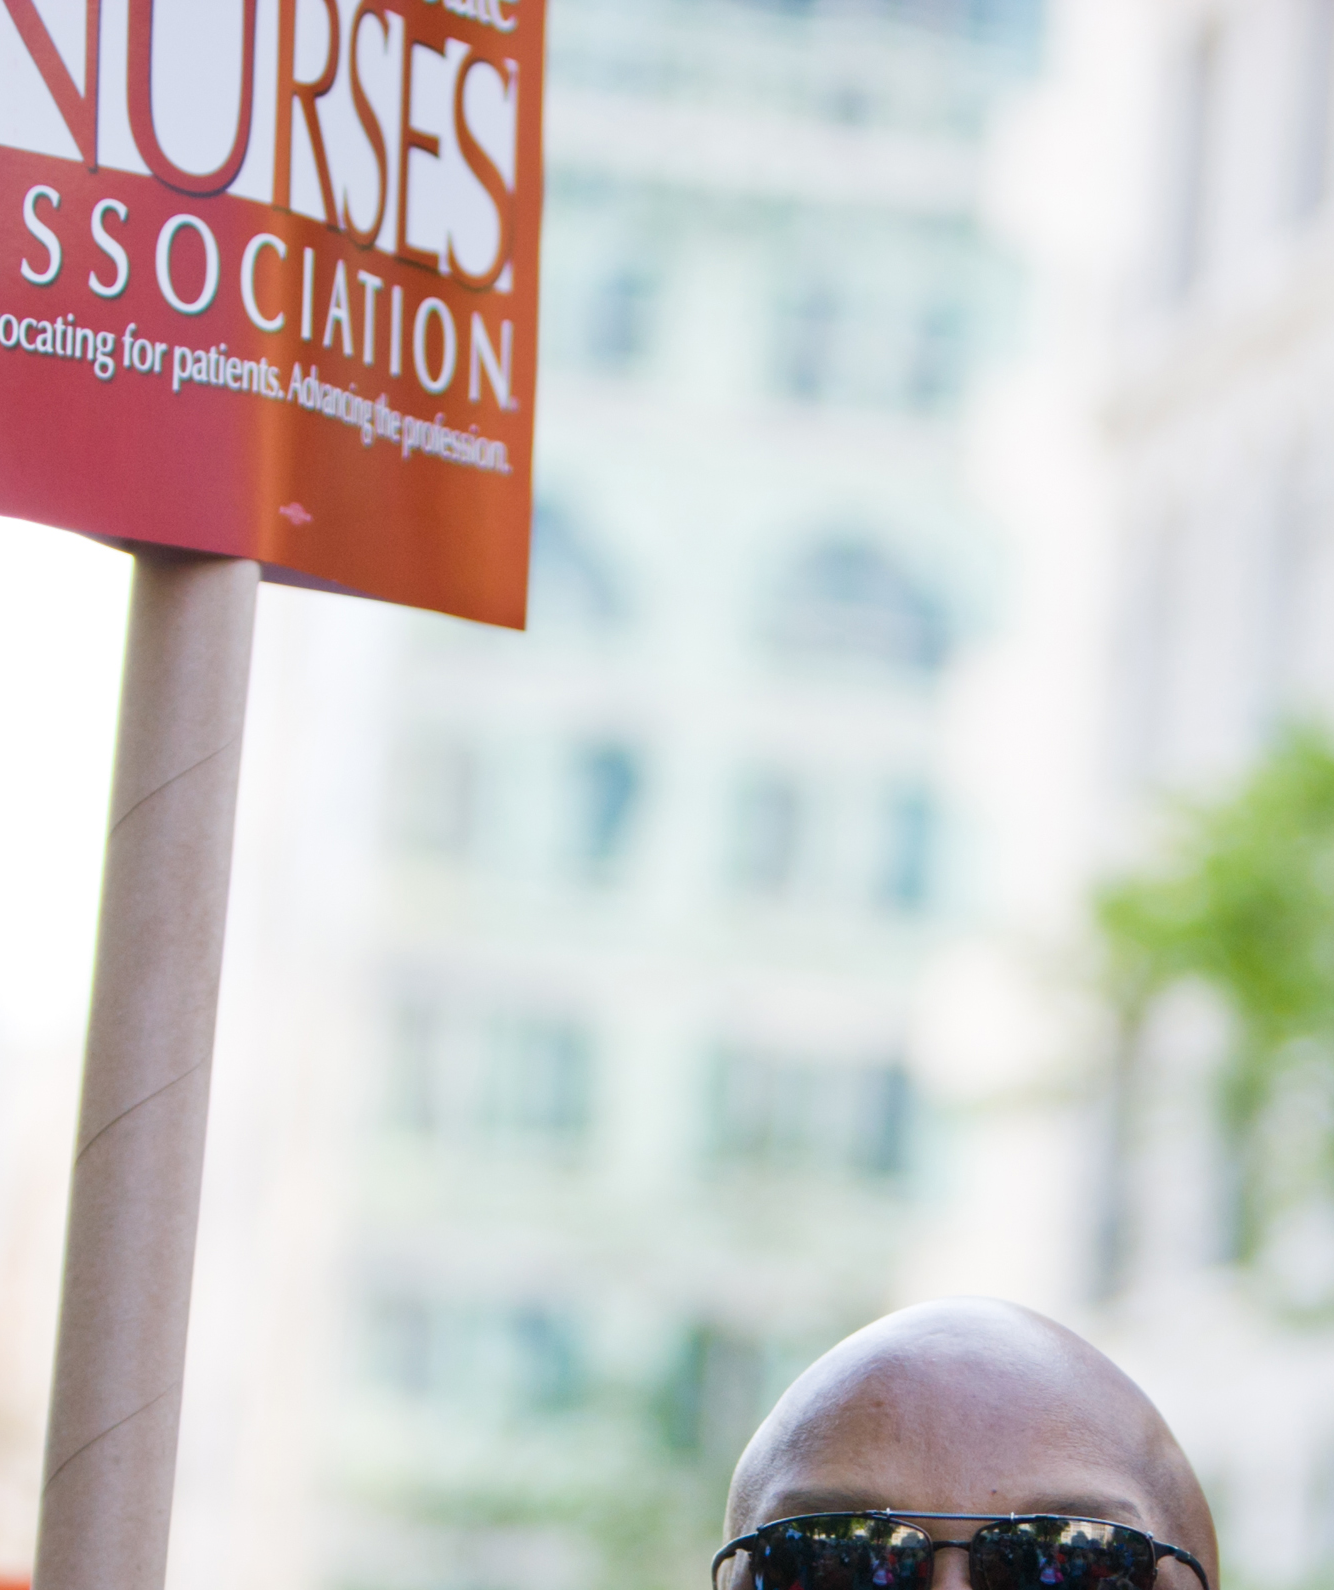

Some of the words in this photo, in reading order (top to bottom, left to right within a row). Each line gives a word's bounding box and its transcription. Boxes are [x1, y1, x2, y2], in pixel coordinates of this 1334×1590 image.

[122, 322, 168, 374] for
[172, 343, 285, 401] patients.
[287, 361, 374, 446] Advancing
[374, 393, 402, 444] the
[402, 412, 512, 476] profession.
